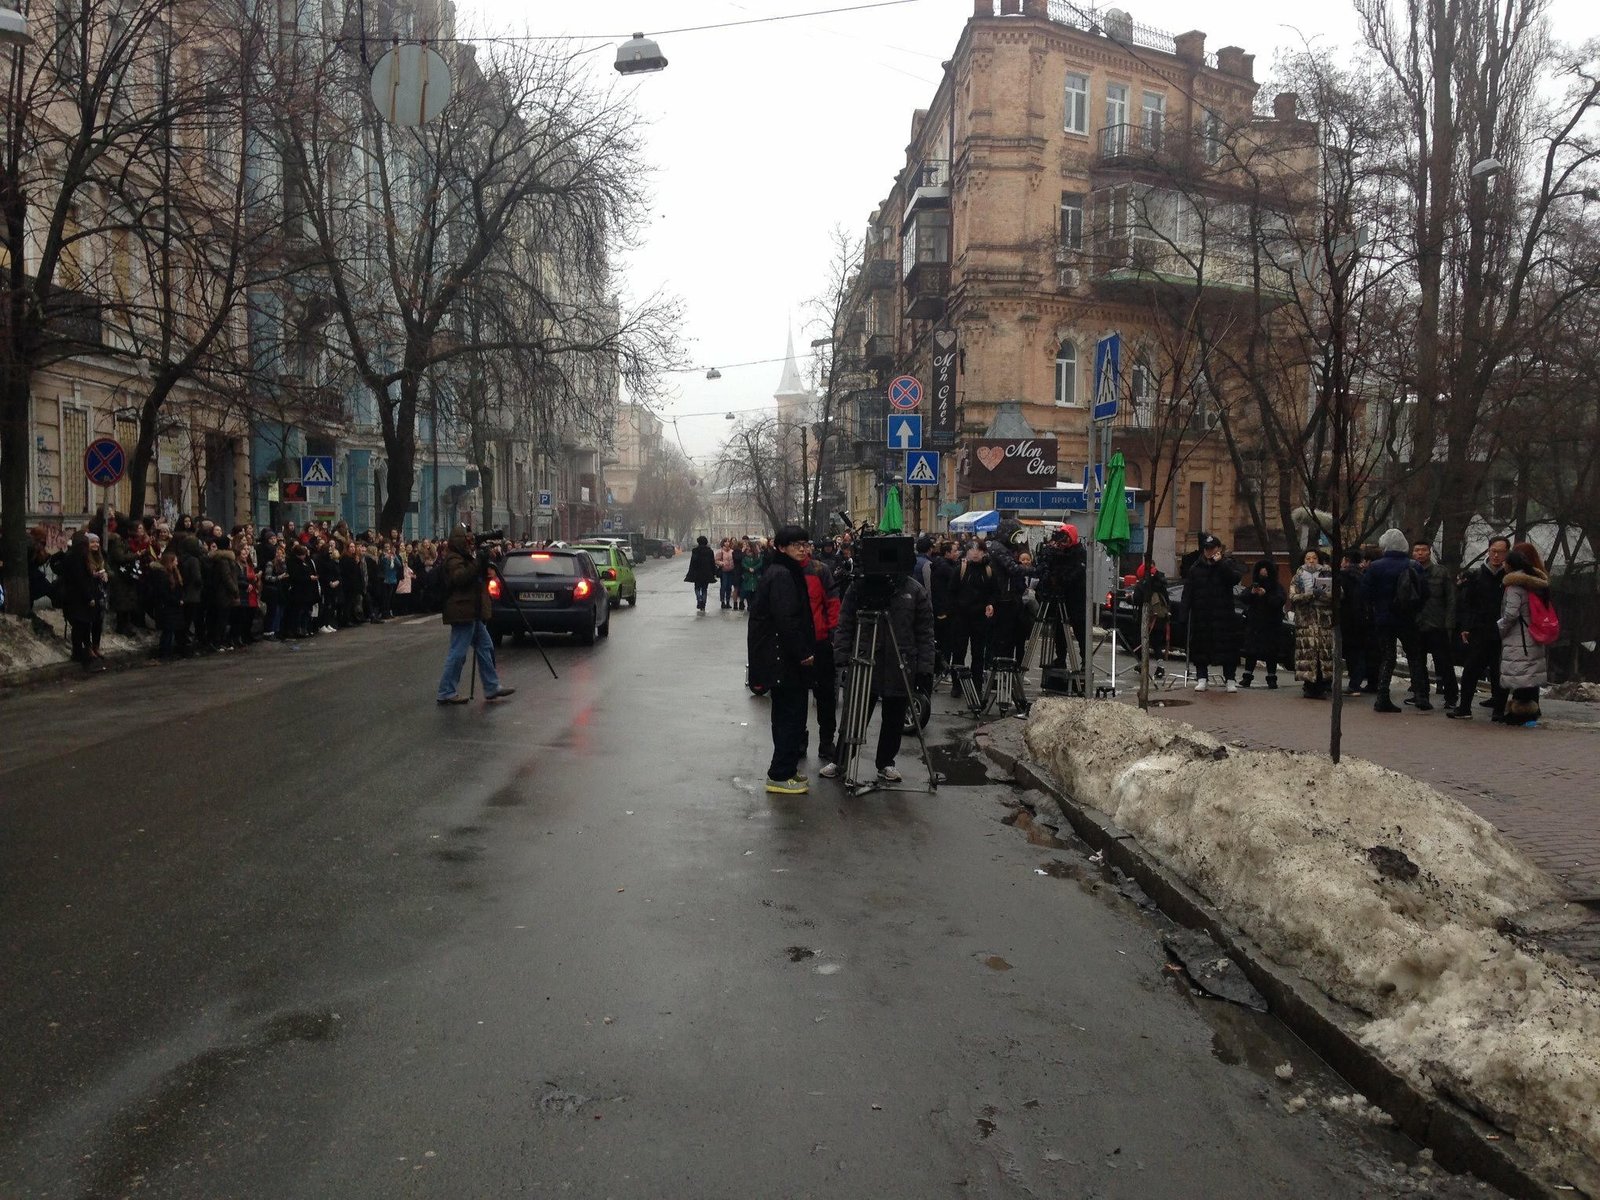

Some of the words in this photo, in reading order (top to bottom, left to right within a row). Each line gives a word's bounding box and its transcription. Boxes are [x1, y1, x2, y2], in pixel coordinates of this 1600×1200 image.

[933, 352, 957, 382] Mon
[938, 384, 951, 426] Cher
[1005, 440, 1043, 458] Mon
[1026, 457, 1057, 475] Cher
[1004, 496, 1035, 504] ПРЕССА
[1051, 496, 1077, 504] ПРЕСА
